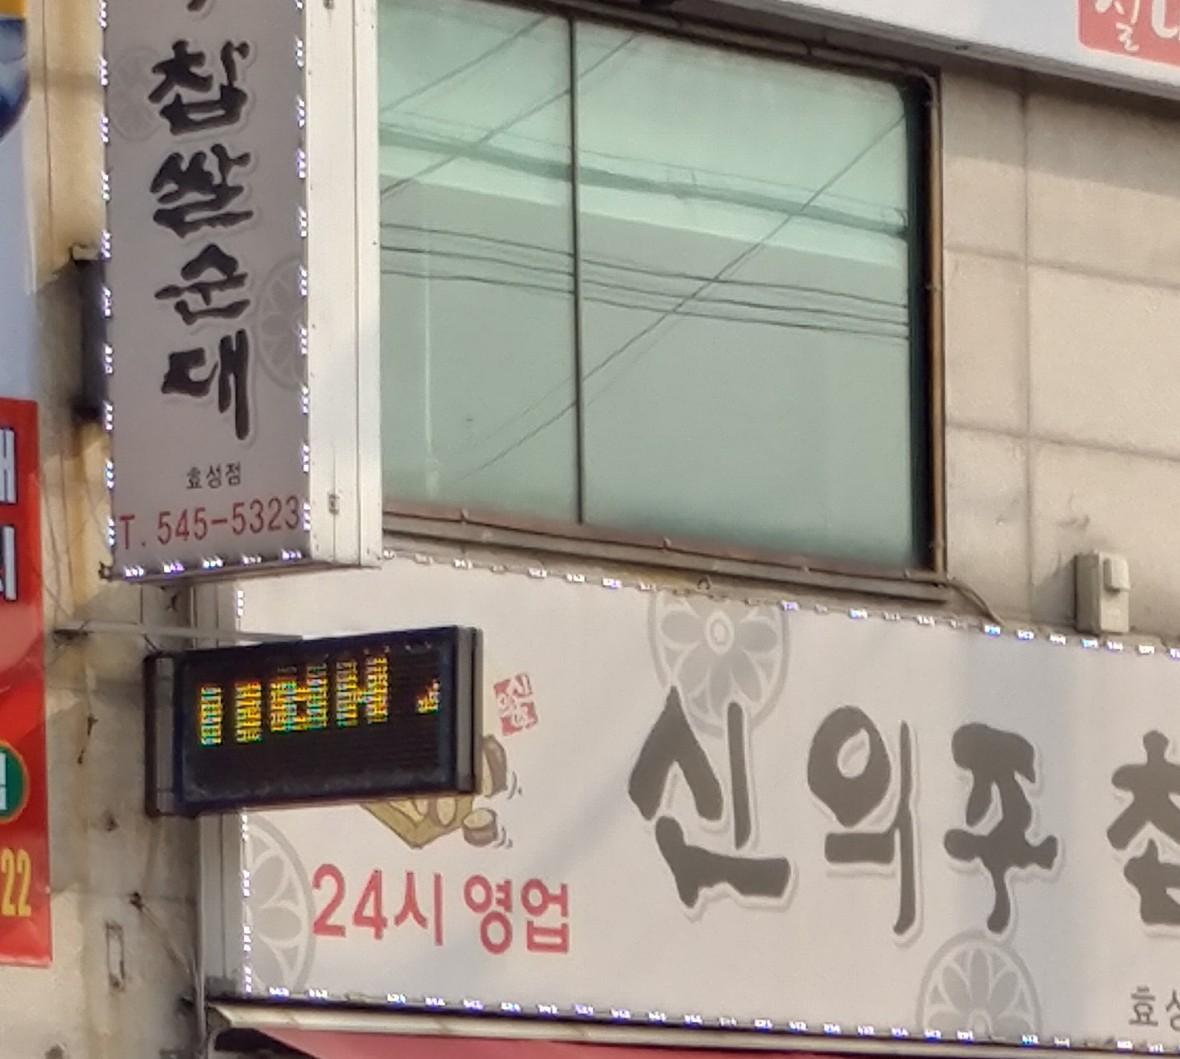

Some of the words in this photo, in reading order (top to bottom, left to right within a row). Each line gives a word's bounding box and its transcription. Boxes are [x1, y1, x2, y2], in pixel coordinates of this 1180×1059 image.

[186, 463, 242, 489] 효성점
[628, 685, 1058, 936] 신의주
[312, 864, 443, 946] 24시
[464, 875, 570, 955] 영업
